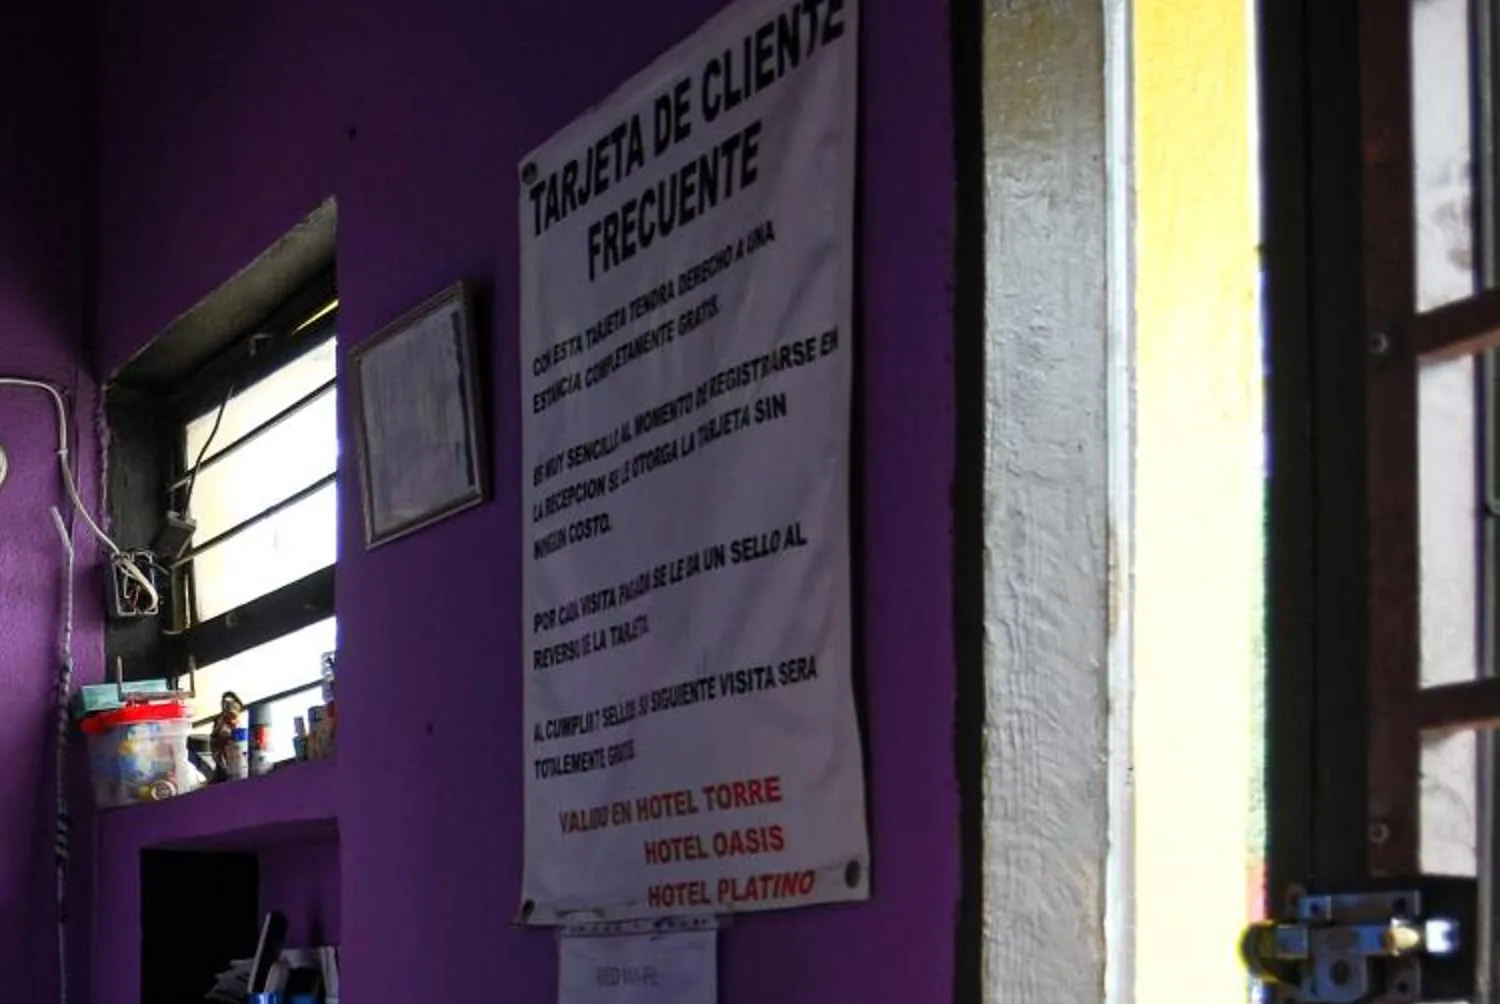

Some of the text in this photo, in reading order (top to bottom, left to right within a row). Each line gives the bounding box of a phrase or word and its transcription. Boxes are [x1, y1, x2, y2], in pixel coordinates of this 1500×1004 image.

[530, 0, 846, 237] TARJETA DE CLIENTE
[588, 119, 762, 282] FRECUENTE
[553, 332, 583, 365] ESTA
[629, 279, 675, 321] TENDRA
[678, 246, 734, 297] DERECHO
[735, 239, 744, 261] A
[747, 220, 775, 253] UNA
[585, 319, 676, 388] COMPLETAMENTE
[634, 391, 693, 436] MOMENTO
[709, 340, 817, 400] REGISTRARSE
[545, 474, 606, 518] RECEPCION
[632, 439, 678, 478] OTORGA
[681, 431, 695, 459] LA
[697, 402, 751, 450] TARJETA
[754, 391, 787, 424] SIN
[580, 588, 617, 618] VISITA
[652, 564, 667, 590] SE
[669, 560, 684, 587] LE
[703, 543, 726, 572] UN
[730, 529, 782, 566] SELLO
[782, 521, 808, 550] AL
[593, 629, 607, 651] LA
[651, 675, 717, 713] SIGUIENTE
[719, 664, 776, 698] VISITA
[778, 655, 819, 687] SERA
[611, 800, 633, 827] EN
[636, 788, 699, 823] HOTEL
[703, 775, 782, 813] TORRE
[644, 824, 785, 866] HOTEL OASIS
[648, 868, 816, 908] HOTEL PLATINO
